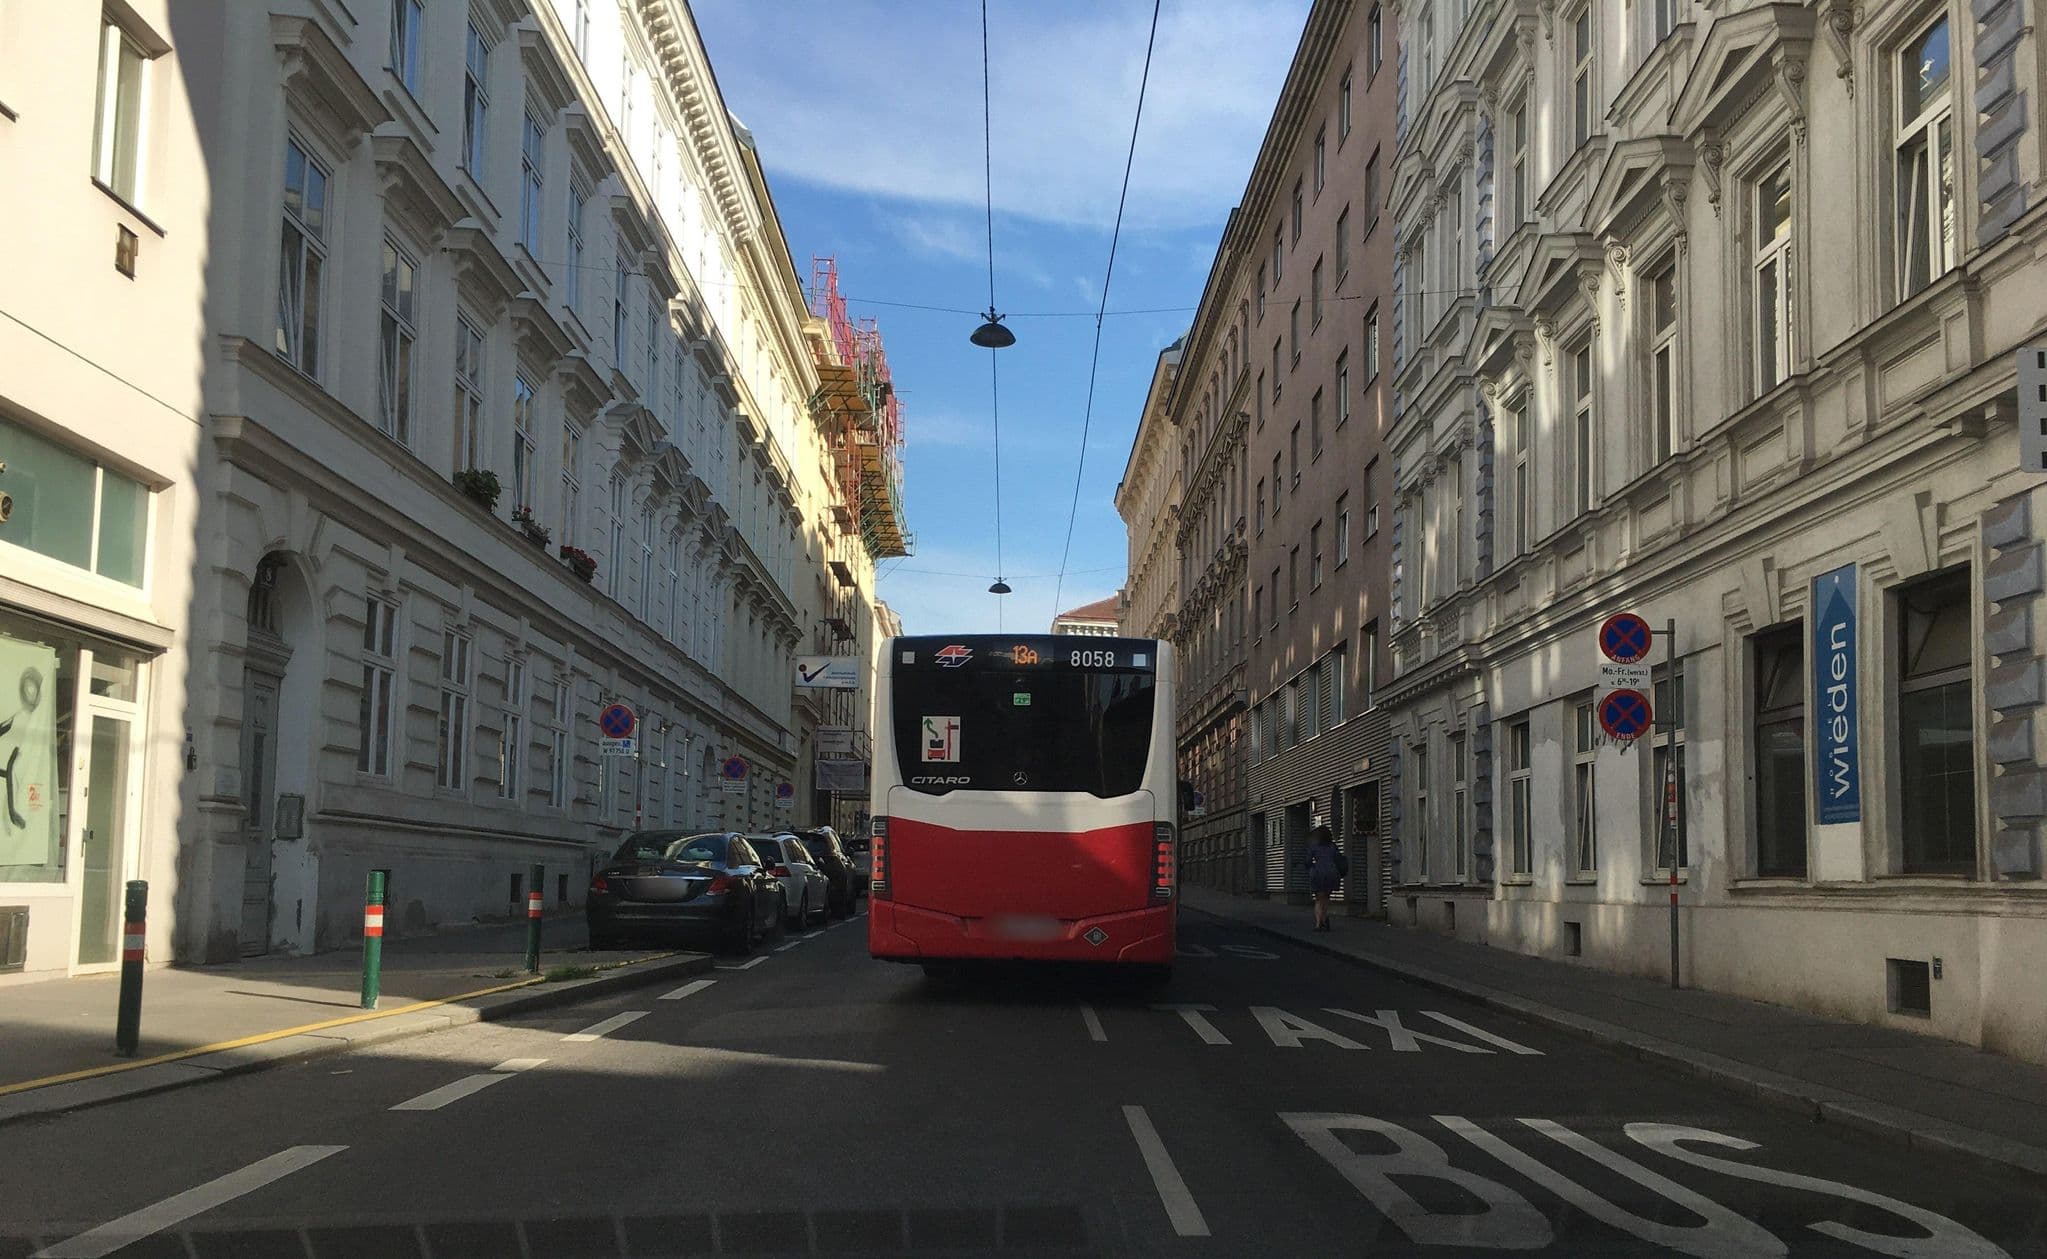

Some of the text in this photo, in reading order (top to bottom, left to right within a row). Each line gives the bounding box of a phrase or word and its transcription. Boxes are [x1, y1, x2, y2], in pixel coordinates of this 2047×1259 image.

[1012, 645, 1038, 665] 13A
[1070, 650, 1115, 669] 8058
[1610, 653, 1641, 664] ANFANG
[1827, 621, 1850, 799] wieden
[1615, 732, 1637, 741] ENDE
[911, 775, 971, 785] CITARO
[1150, 1003, 1546, 1055] TAXI
[1276, 1112, 2012, 1259] BUS
